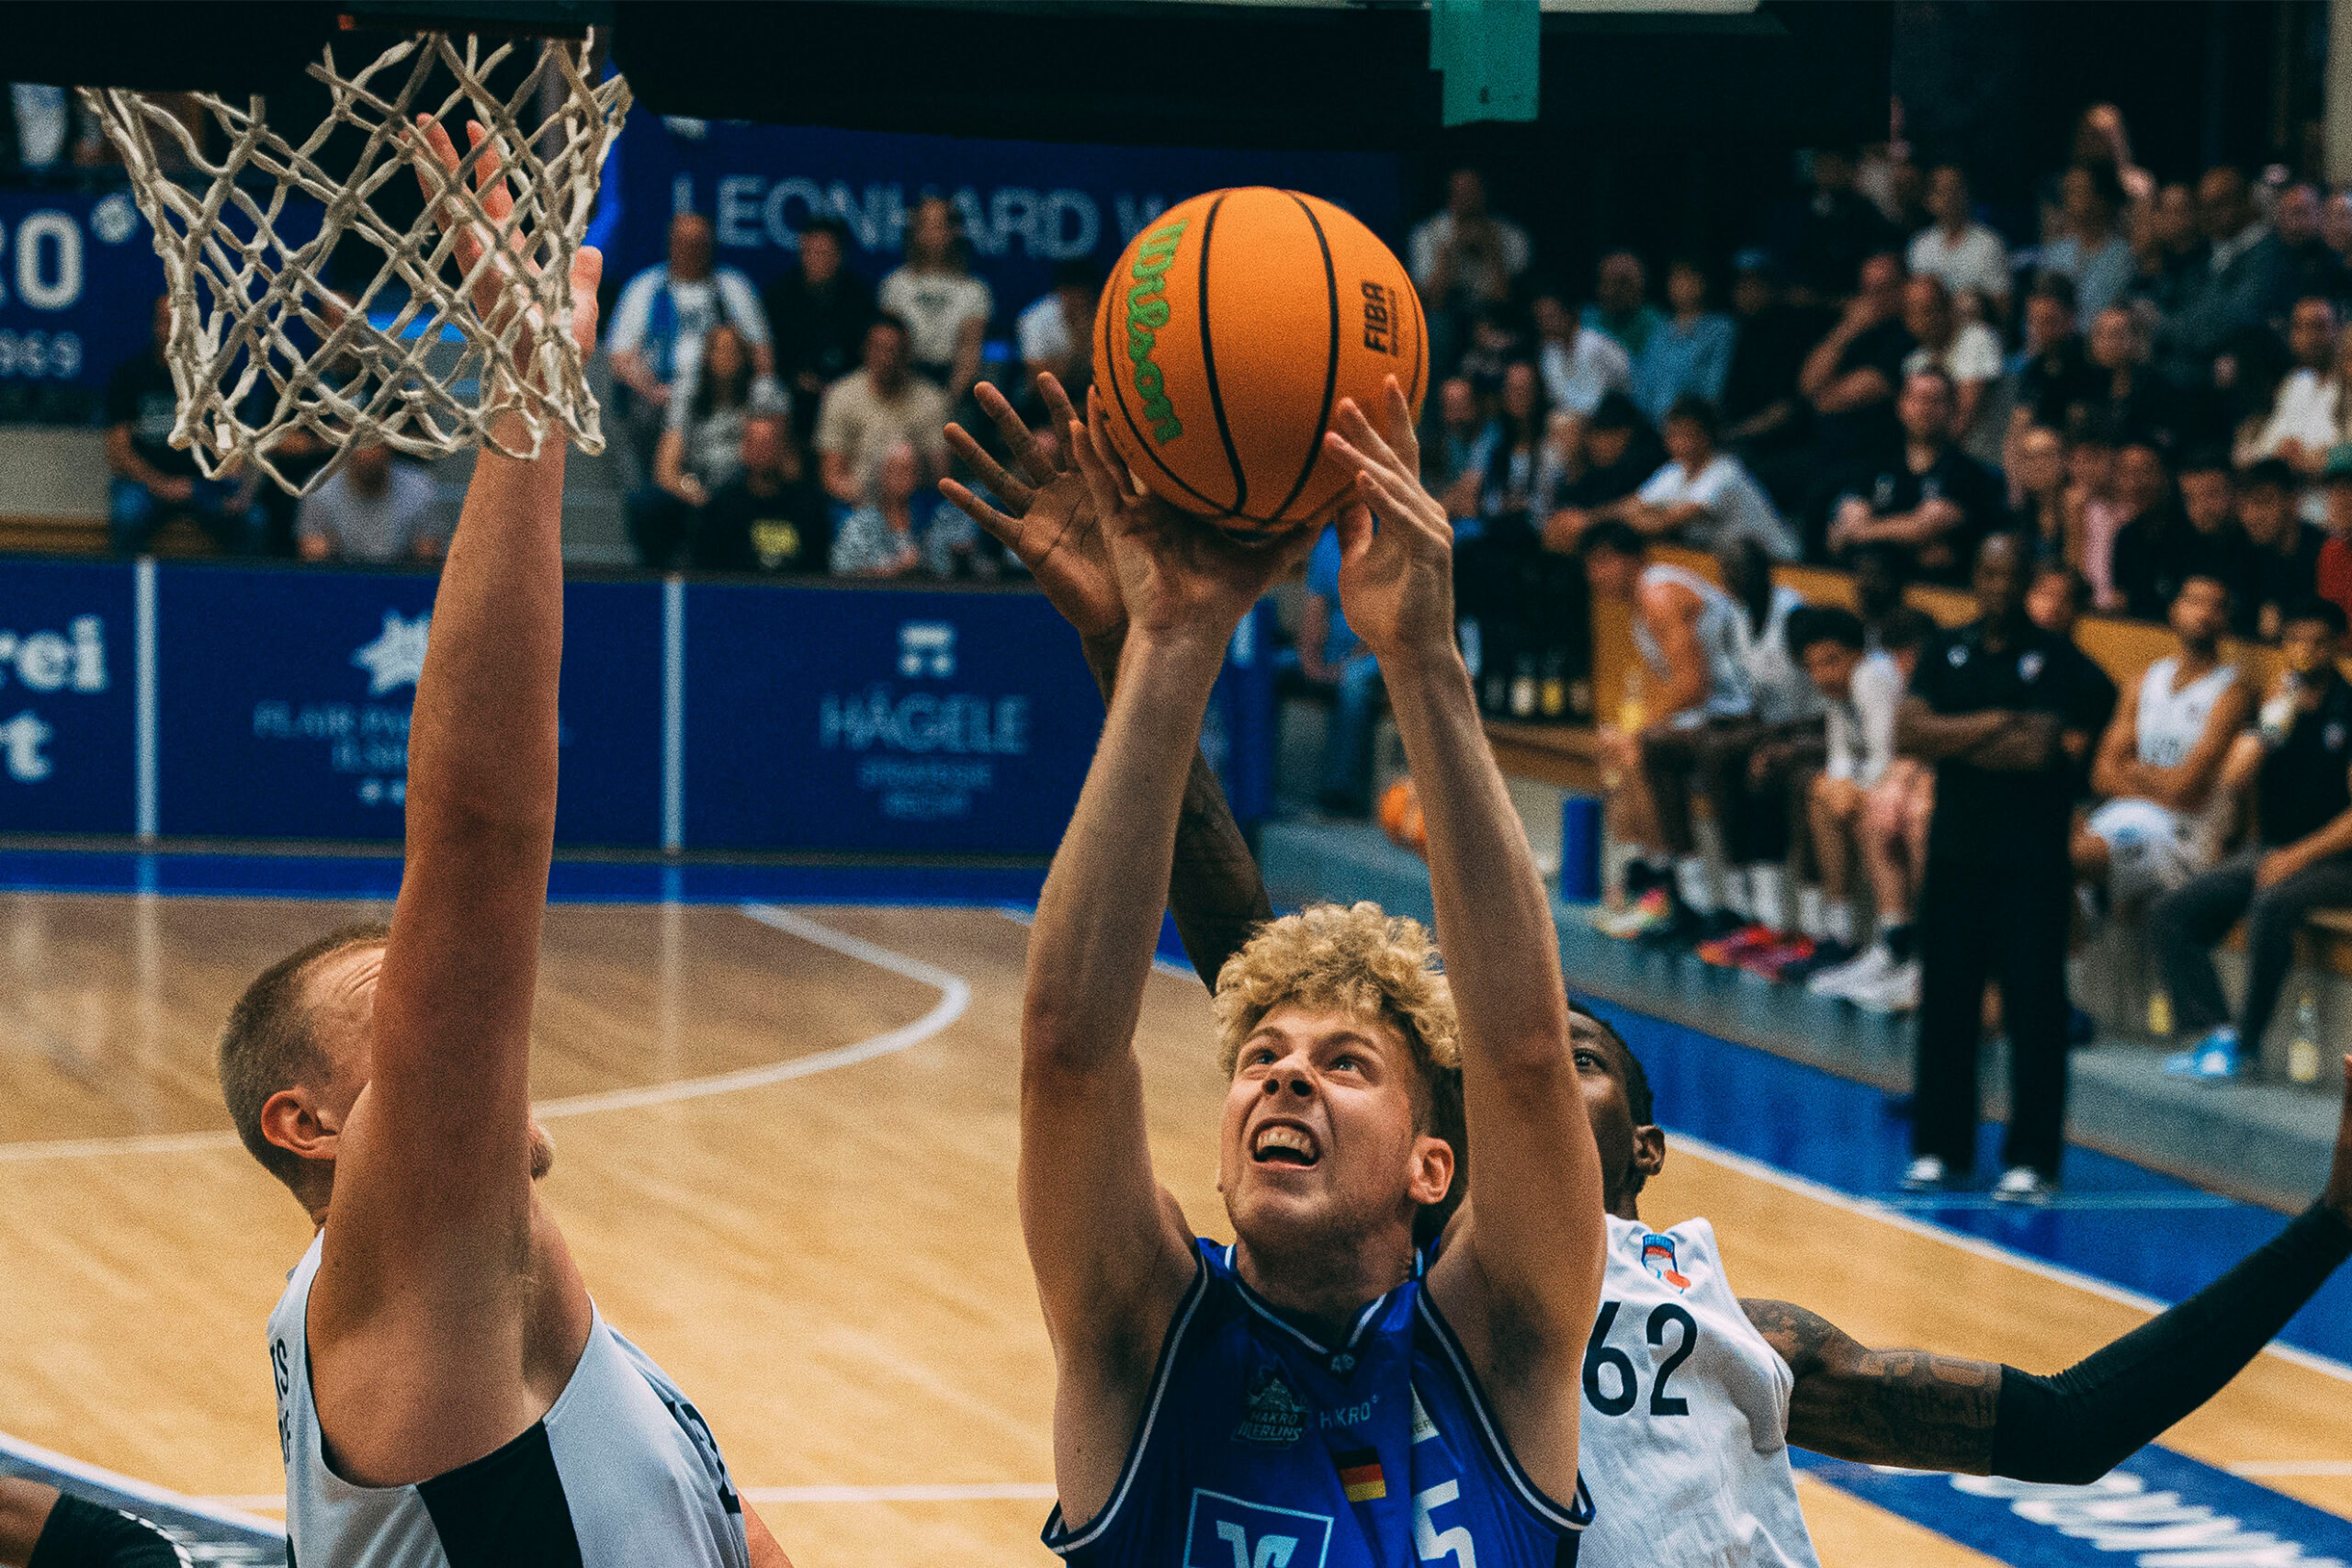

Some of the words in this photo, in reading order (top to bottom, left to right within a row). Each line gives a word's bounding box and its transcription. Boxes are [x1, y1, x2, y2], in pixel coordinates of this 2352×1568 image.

[0, 209, 83, 310] O
[1126, 218, 1188, 446] Wilson
[1362, 281, 1387, 355] FIBA
[1582, 1301, 1698, 1416] 62
[1237, 1422, 1303, 1439] MERLINS
[1250, 1411, 1298, 1424] HAKRO
